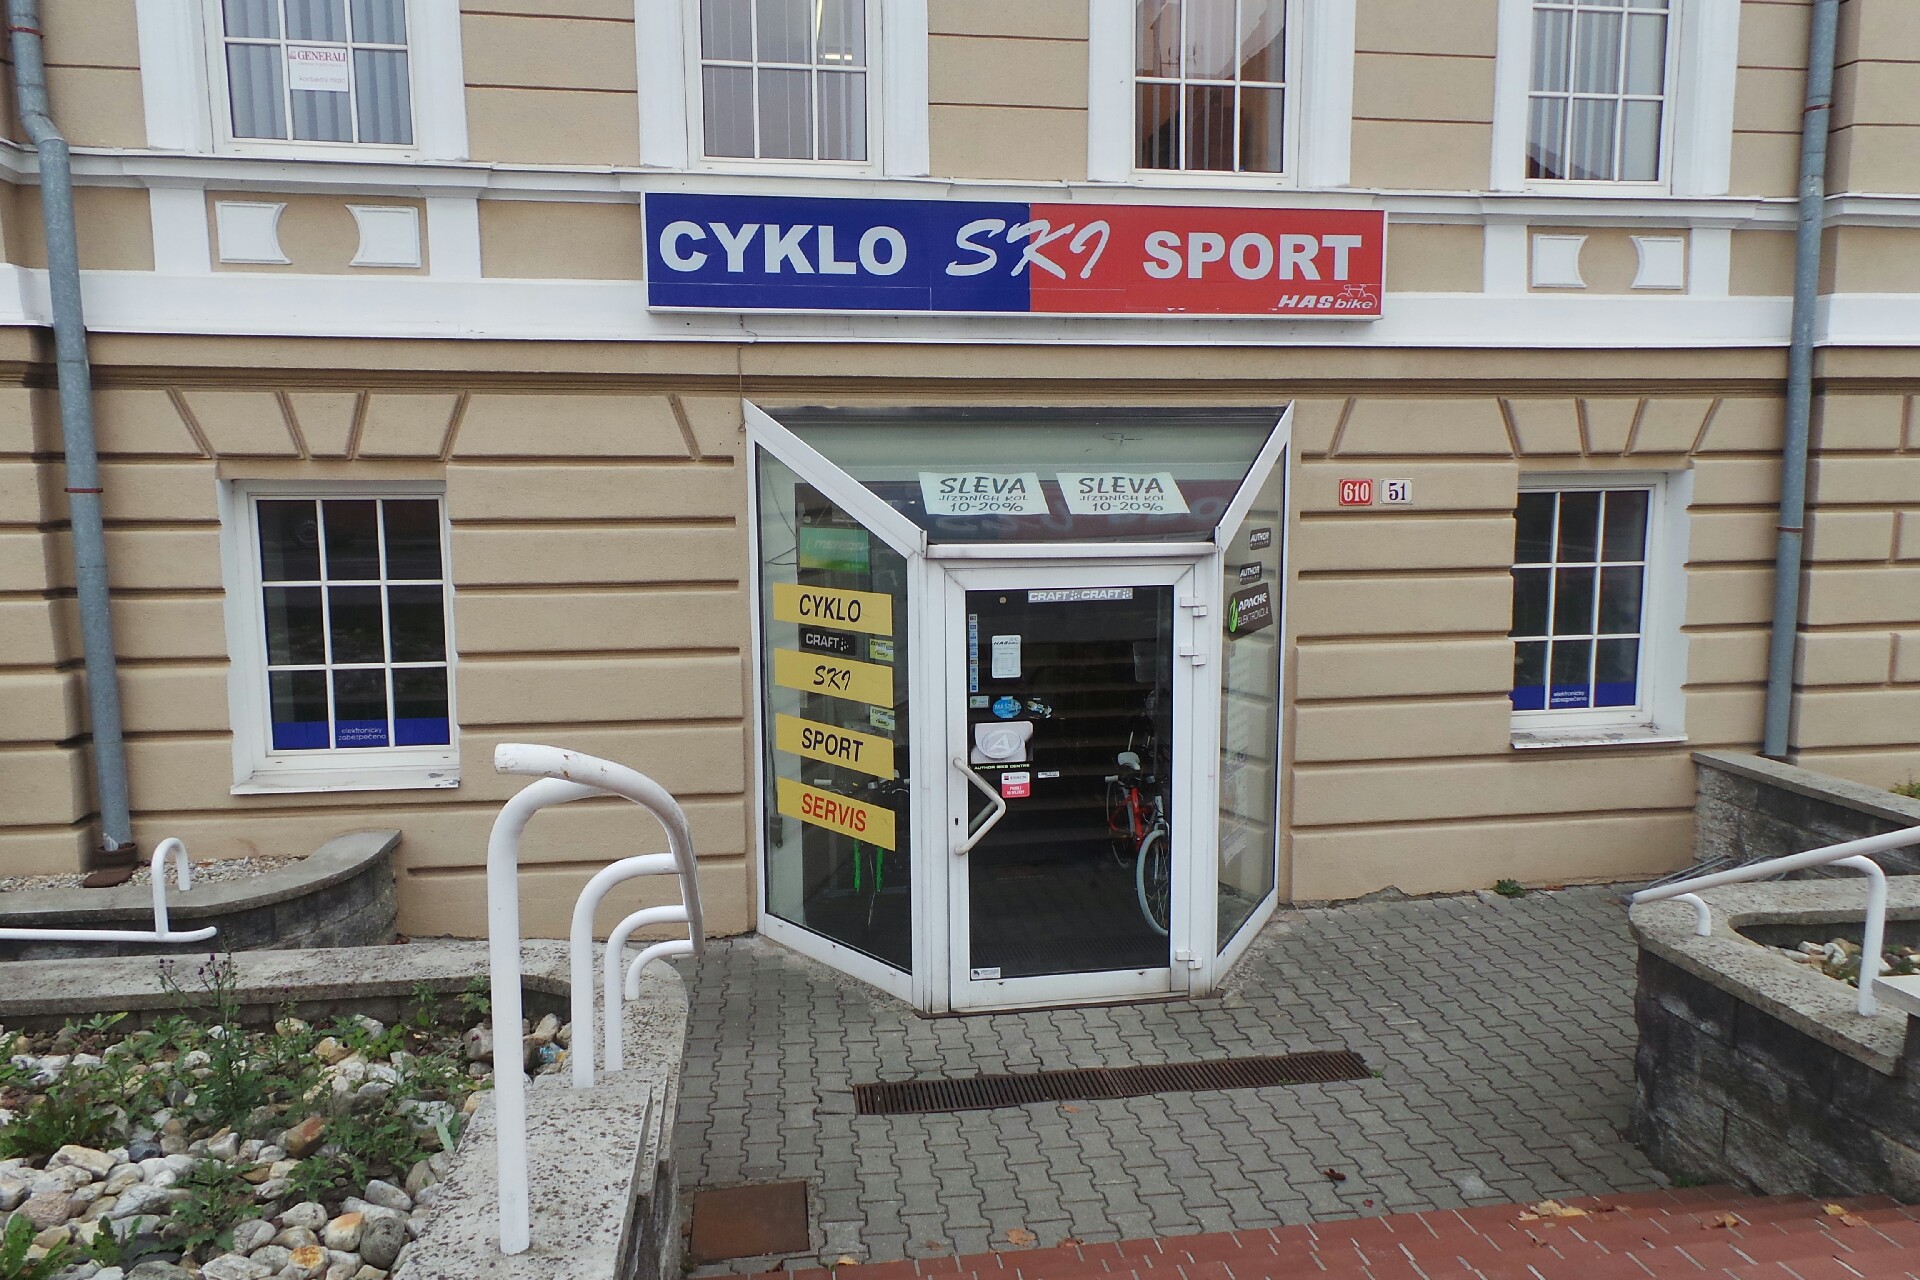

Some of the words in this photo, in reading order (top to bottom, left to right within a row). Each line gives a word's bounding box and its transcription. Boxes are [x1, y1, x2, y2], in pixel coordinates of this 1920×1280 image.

[297, 50, 346, 62] GENERALI
[659, 220, 908, 276] CYKLO
[945, 218, 1111, 280] SKI
[1143, 230, 1363, 281] SPORT
[939, 476, 1026, 494] SLEVA
[1078, 476, 1164, 494] SLEVA
[1342, 482, 1370, 502] 610
[1388, 482, 1406, 501] 51
[950, 502, 1024, 512] 10-20%
[1092, 502, 1164, 512] 10-20%
[1250, 532, 1269, 542] AUTHOR
[1239, 565, 1260, 578] AUTHOR
[1029, 591, 1069, 601] CRAFT
[1081, 589, 1121, 599] CRAFT
[1238, 592, 1268, 612] APACHE
[799, 594, 861, 623] CYKLO
[805, 633, 840, 649] CRAFT
[812, 665, 851, 691] SKI
[801, 727, 864, 762] SPORT
[801, 793, 867, 833] SERVIS
